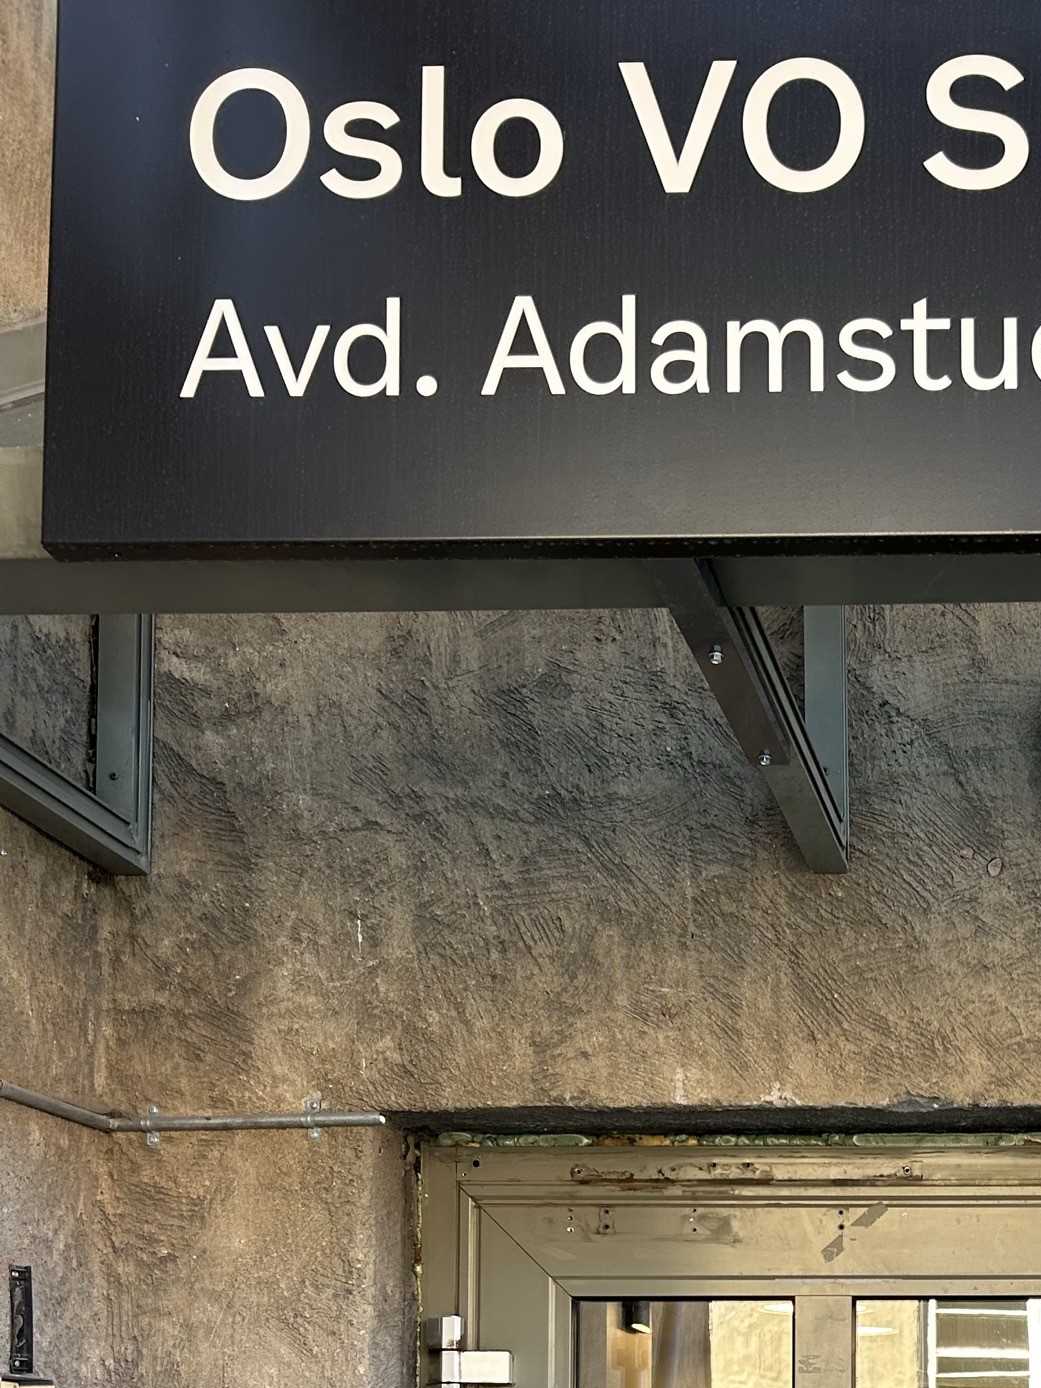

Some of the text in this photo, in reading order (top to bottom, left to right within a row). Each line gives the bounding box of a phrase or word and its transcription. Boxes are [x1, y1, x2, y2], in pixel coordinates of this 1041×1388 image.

[188, 65, 565, 201] Oslo
[617, 57, 866, 194] VO
[179, 297, 438, 398] Avd.
